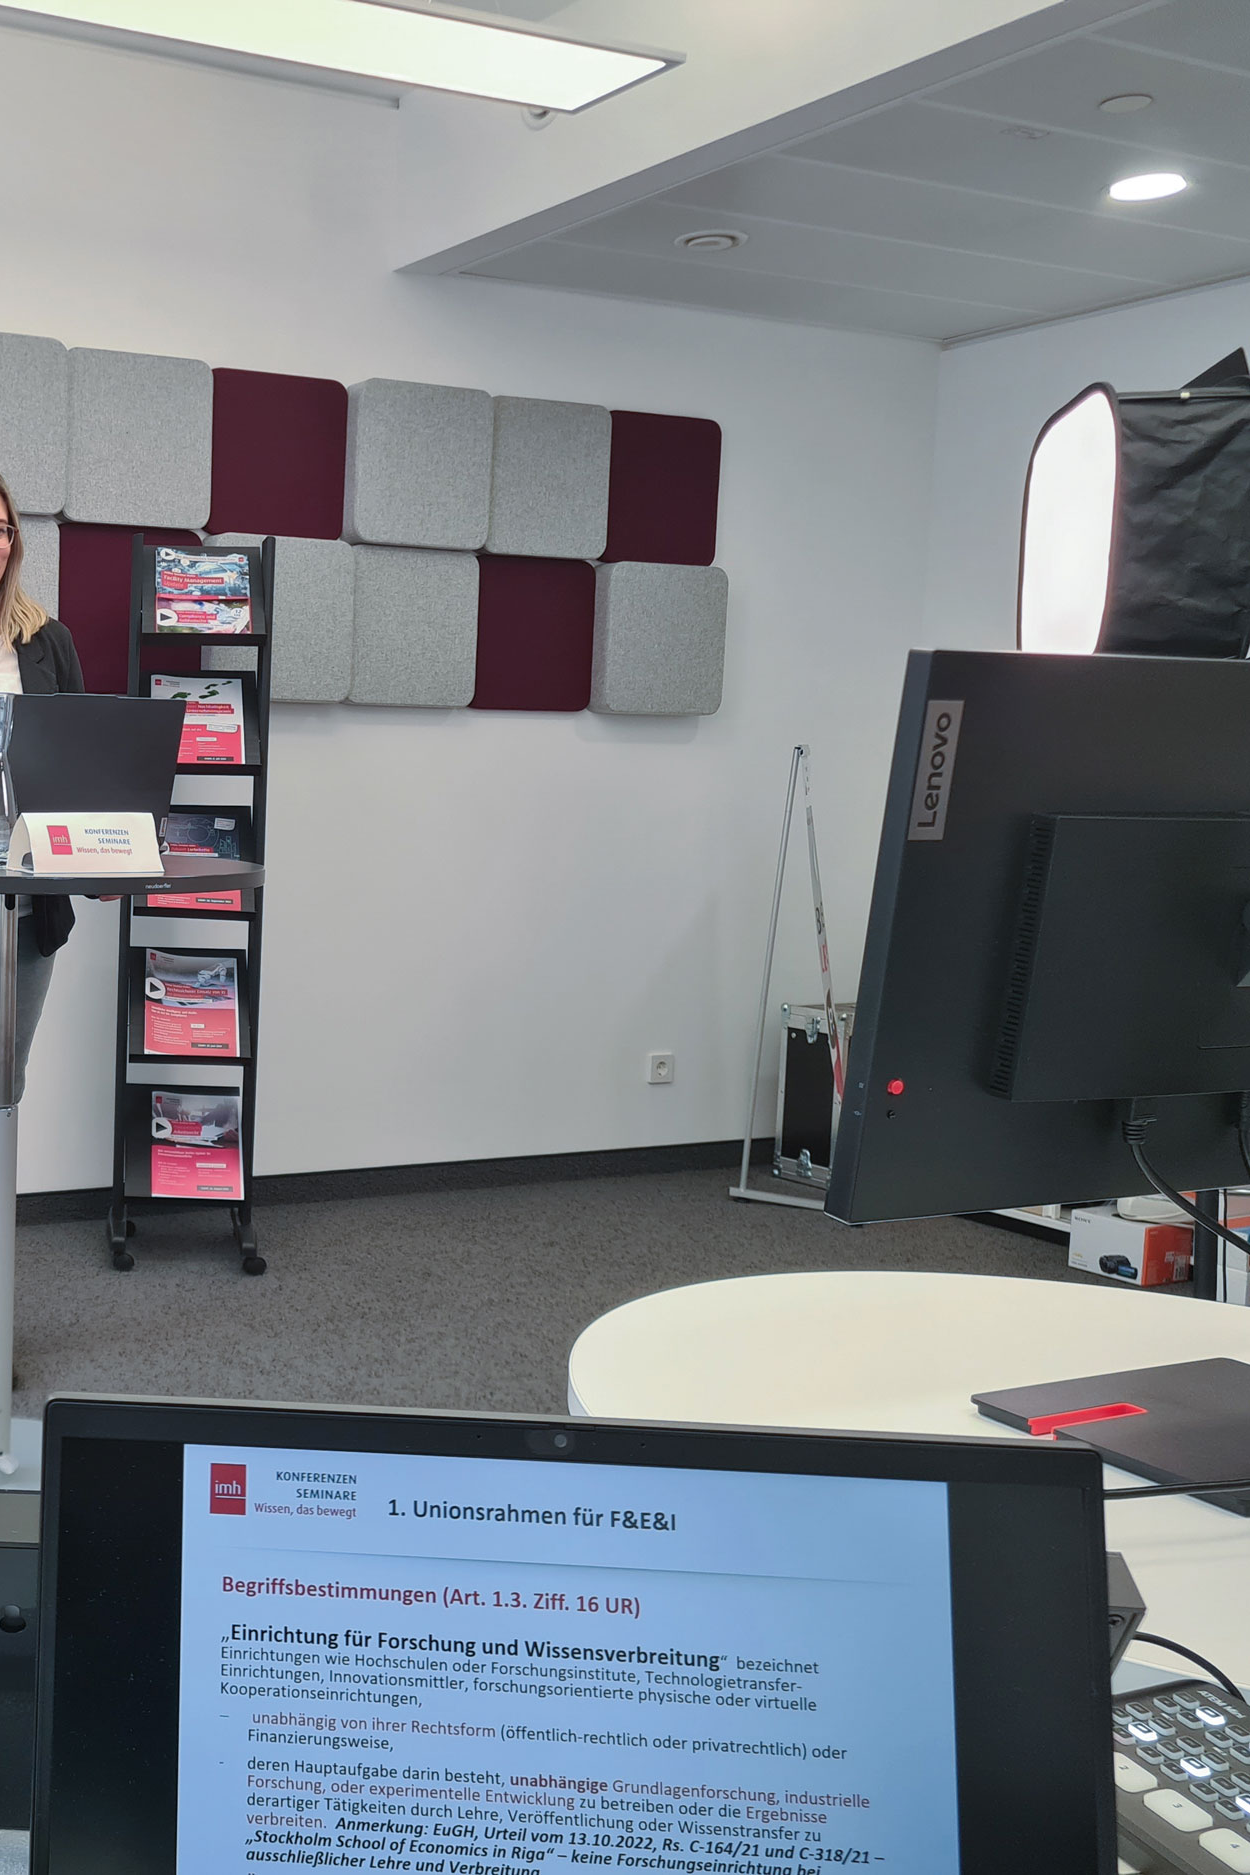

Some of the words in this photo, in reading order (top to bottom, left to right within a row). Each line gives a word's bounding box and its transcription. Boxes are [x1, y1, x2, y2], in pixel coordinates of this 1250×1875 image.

[917, 712, 952, 828] Lenovo
[84, 828, 129, 836] KONFERENZEN
[97, 837, 130, 845] SEMINARE
[76, 846, 99, 854] Wissen,
[111, 847, 132, 856] bewegt
[215, 1480, 242, 1495] imh
[276, 1471, 357, 1484] KONFERENZEN
[296, 1488, 357, 1501] SEMINARE
[254, 1502, 294, 1516] Wissen,
[296, 1504, 314, 1515] das
[317, 1505, 356, 1520] bewegt
[388, 1499, 406, 1517] 1.
[413, 1500, 566, 1525] Unionsrahmen
[572, 1506, 604, 1527] für
[610, 1510, 676, 1531] F&E&I
[222, 1576, 436, 1606] Begriffsbestimmungen
[443, 1586, 486, 1609] (Art.
[492, 1591, 527, 1609] 1.3.
[533, 1592, 569, 1611] Ziff.
[576, 1595, 599, 1613] 16
[606, 1597, 640, 1619] UR)
[343, 1629, 372, 1648] für
[378, 1632, 476, 1658] Forschung
[482, 1639, 518, 1656] und
[736, 1656, 819, 1674] bezeichnet
[221, 1646, 320, 1666] Einrichtungen
[324, 1652, 350, 1666] wie
[355, 1654, 448, 1671] Hochschulen
[452, 1659, 487, 1673] oder
[491, 1661, 640, 1685] Forschungsinstitute,
[644, 1670, 802, 1692] Technologietransfer-
[220, 1681, 422, 1708] Kooperationseinrichtungen,
[221, 1663, 324, 1685] Einrichtungen,
[329, 1670, 468, 1693] Innovationsmittler,
[473, 1677, 634, 1700] forschungsorientierte
[638, 1687, 711, 1705] physische
[715, 1692, 751, 1707] oder
[754, 1695, 817, 1711] virtuelle
[248, 1728, 393, 1752] Finanzierungsweise,
[252, 1711, 337, 1731] unabhängig
[340, 1718, 367, 1730] von
[372, 1717, 407, 1732] ihrer
[411, 1720, 496, 1738] Rechtsform
[501, 1724, 648, 1747] (öffentlich-rechtlich
[652, 1735, 688, 1750] oder
[692, 1738, 807, 1760] privatrechtlich)
[811, 1745, 848, 1760] oder
[247, 1756, 290, 1772] deren
[294, 1759, 398, 1780] Hauptaufgabe
[402, 1765, 440, 1781] darin
[445, 1768, 505, 1788] besteht,
[510, 1774, 608, 1794] unabhängige
[612, 1780, 780, 1806] Grundlagenforschung,
[785, 1790, 870, 1808] industrielle
[248, 1774, 326, 1795] Forschung,
[331, 1779, 365, 1794] oder
[369, 1784, 480, 1802] experimentelle
[486, 1789, 575, 1811] Entwicklung
[579, 1798, 596, 1809] zu
[601, 1795, 674, 1814] betreiben
[678, 1802, 714, 1816] oder
[718, 1804, 741, 1818] die
[746, 1806, 827, 1824] Ergebnisse
[247, 1792, 320, 1812] derartiger
[323, 1797, 406, 1816] Tätigkeiten
[410, 1802, 453, 1818] durch
[458, 1806, 503, 1824] Lehre,
[507, 1809, 634, 1833] Veröffentlichung
[638, 1818, 674, 1832] oder
[677, 1820, 800, 1841] Wissenstransfer
[804, 1831, 821, 1842] zu
[246, 1811, 327, 1829] verbreiten.
[335, 1817, 429, 1838] Anmerkung:
[433, 1823, 478, 1842] EuGH,
[484, 1826, 527, 1842] Urteil
[531, 1832, 564, 1844] vom
[568, 1832, 657, 1853] 13.10.2022,
[662, 1838, 684, 1852] Rs.
[689, 1840, 760, 1858] C-164/21
[765, 1845, 795, 1859] und
[799, 1847, 870, 1865] C-318/21
[335, 1834, 386, 1851] School
[389, 1838, 407, 1855] of
[409, 1839, 489, 1857] Economics
[492, 1844, 506, 1858] in
[571, 1849, 612, 1865] keine
[246, 1849, 366, 1868] ausschließlicher
[369, 1855, 411, 1871] Lehre
[415, 1859, 445, 1873] und
